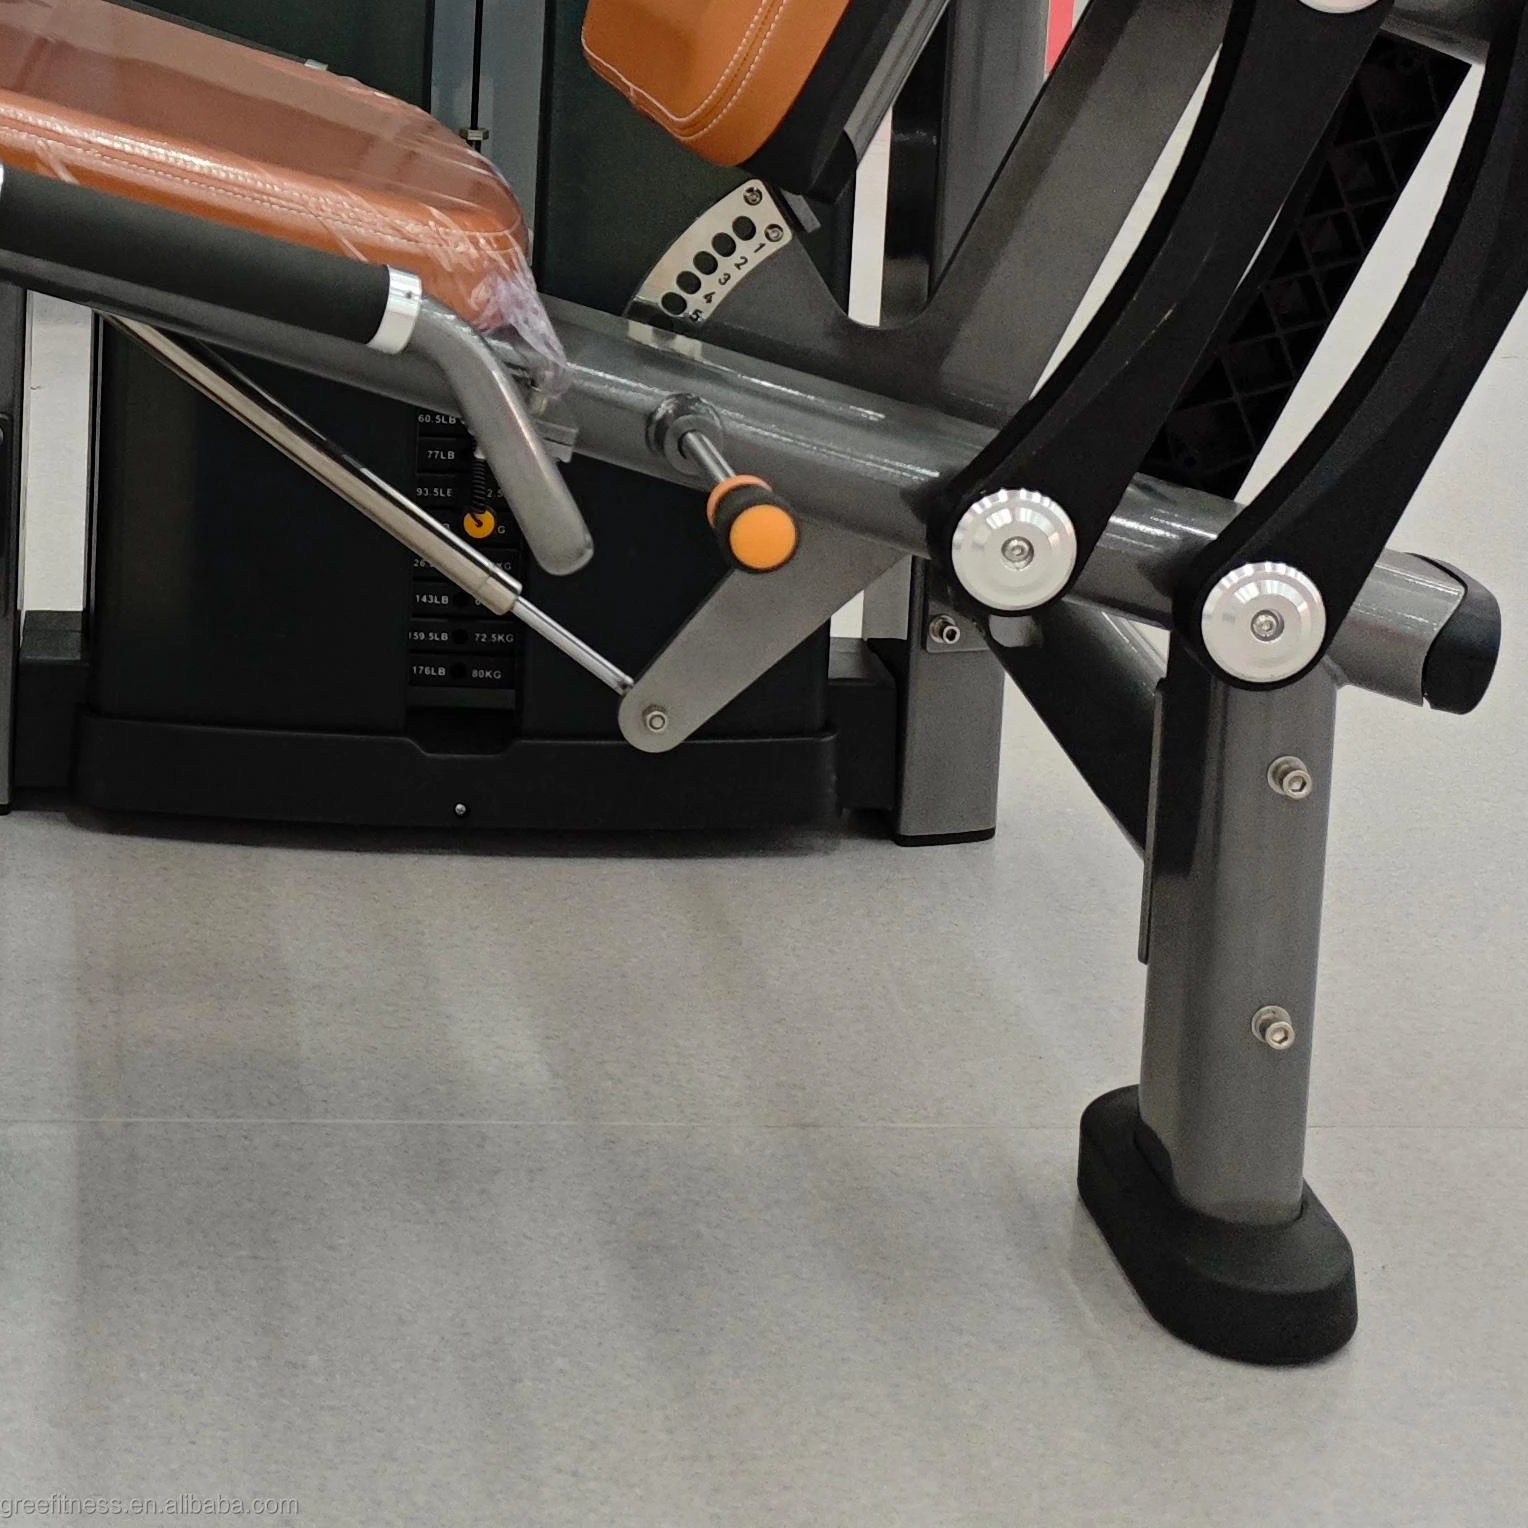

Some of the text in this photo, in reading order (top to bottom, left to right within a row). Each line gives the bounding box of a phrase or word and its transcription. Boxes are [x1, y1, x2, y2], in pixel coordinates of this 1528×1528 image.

[734, 256, 748, 270] 2
[718, 273, 731, 285] 3
[427, 451, 455, 460] 77LB
[416, 594, 449, 605] 143LB
